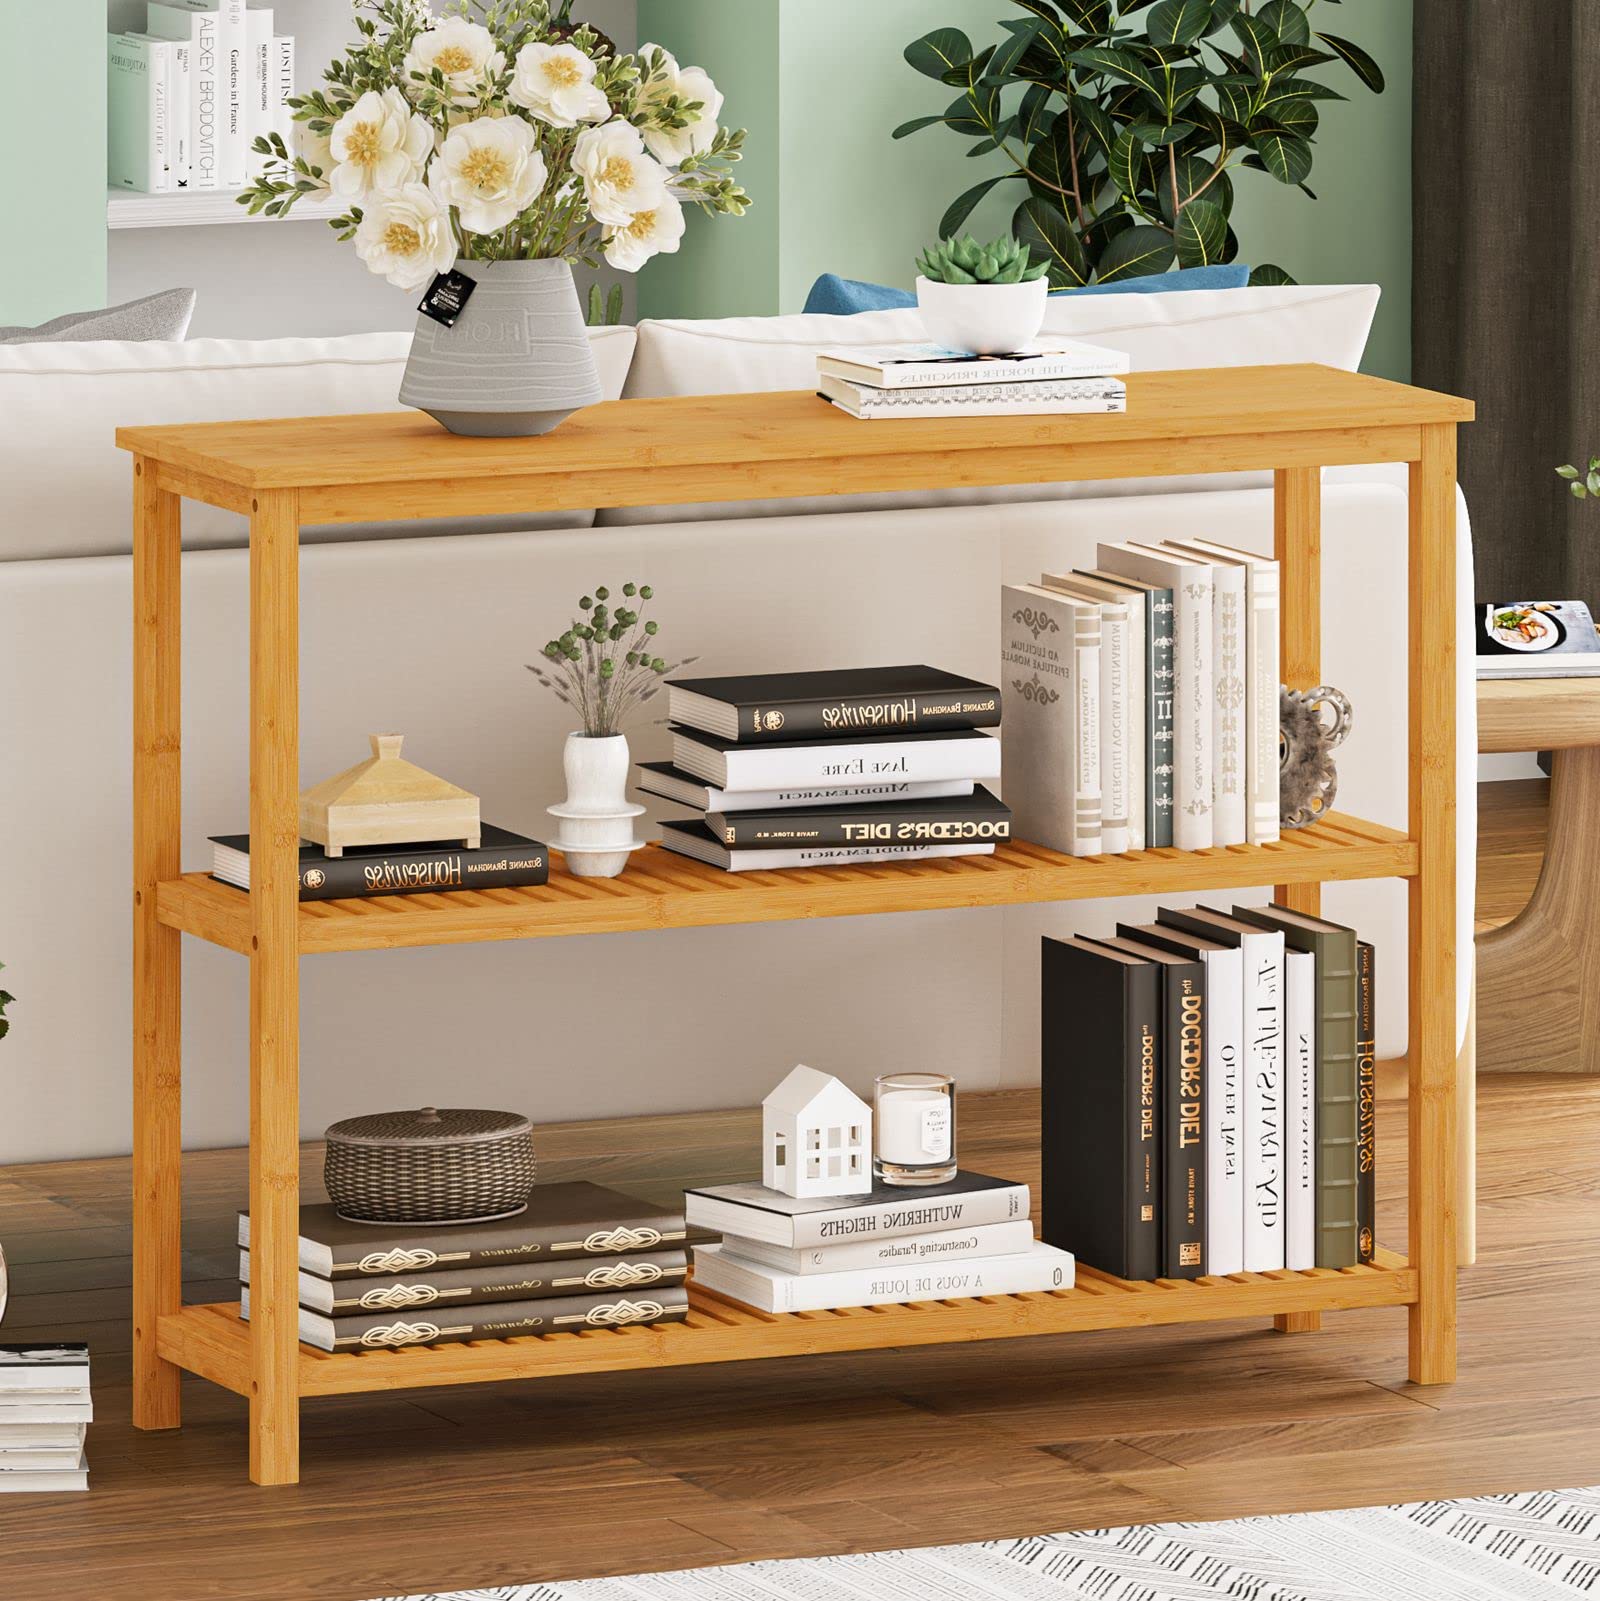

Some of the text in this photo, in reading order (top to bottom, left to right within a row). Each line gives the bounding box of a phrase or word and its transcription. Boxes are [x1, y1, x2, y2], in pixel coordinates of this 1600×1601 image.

[199, 17, 215, 76] ALEXEY
[281, 42, 291, 73] LOST
[230, 49, 240, 135] Gardens in France
[199, 80, 215, 179] BRODOVITCH
